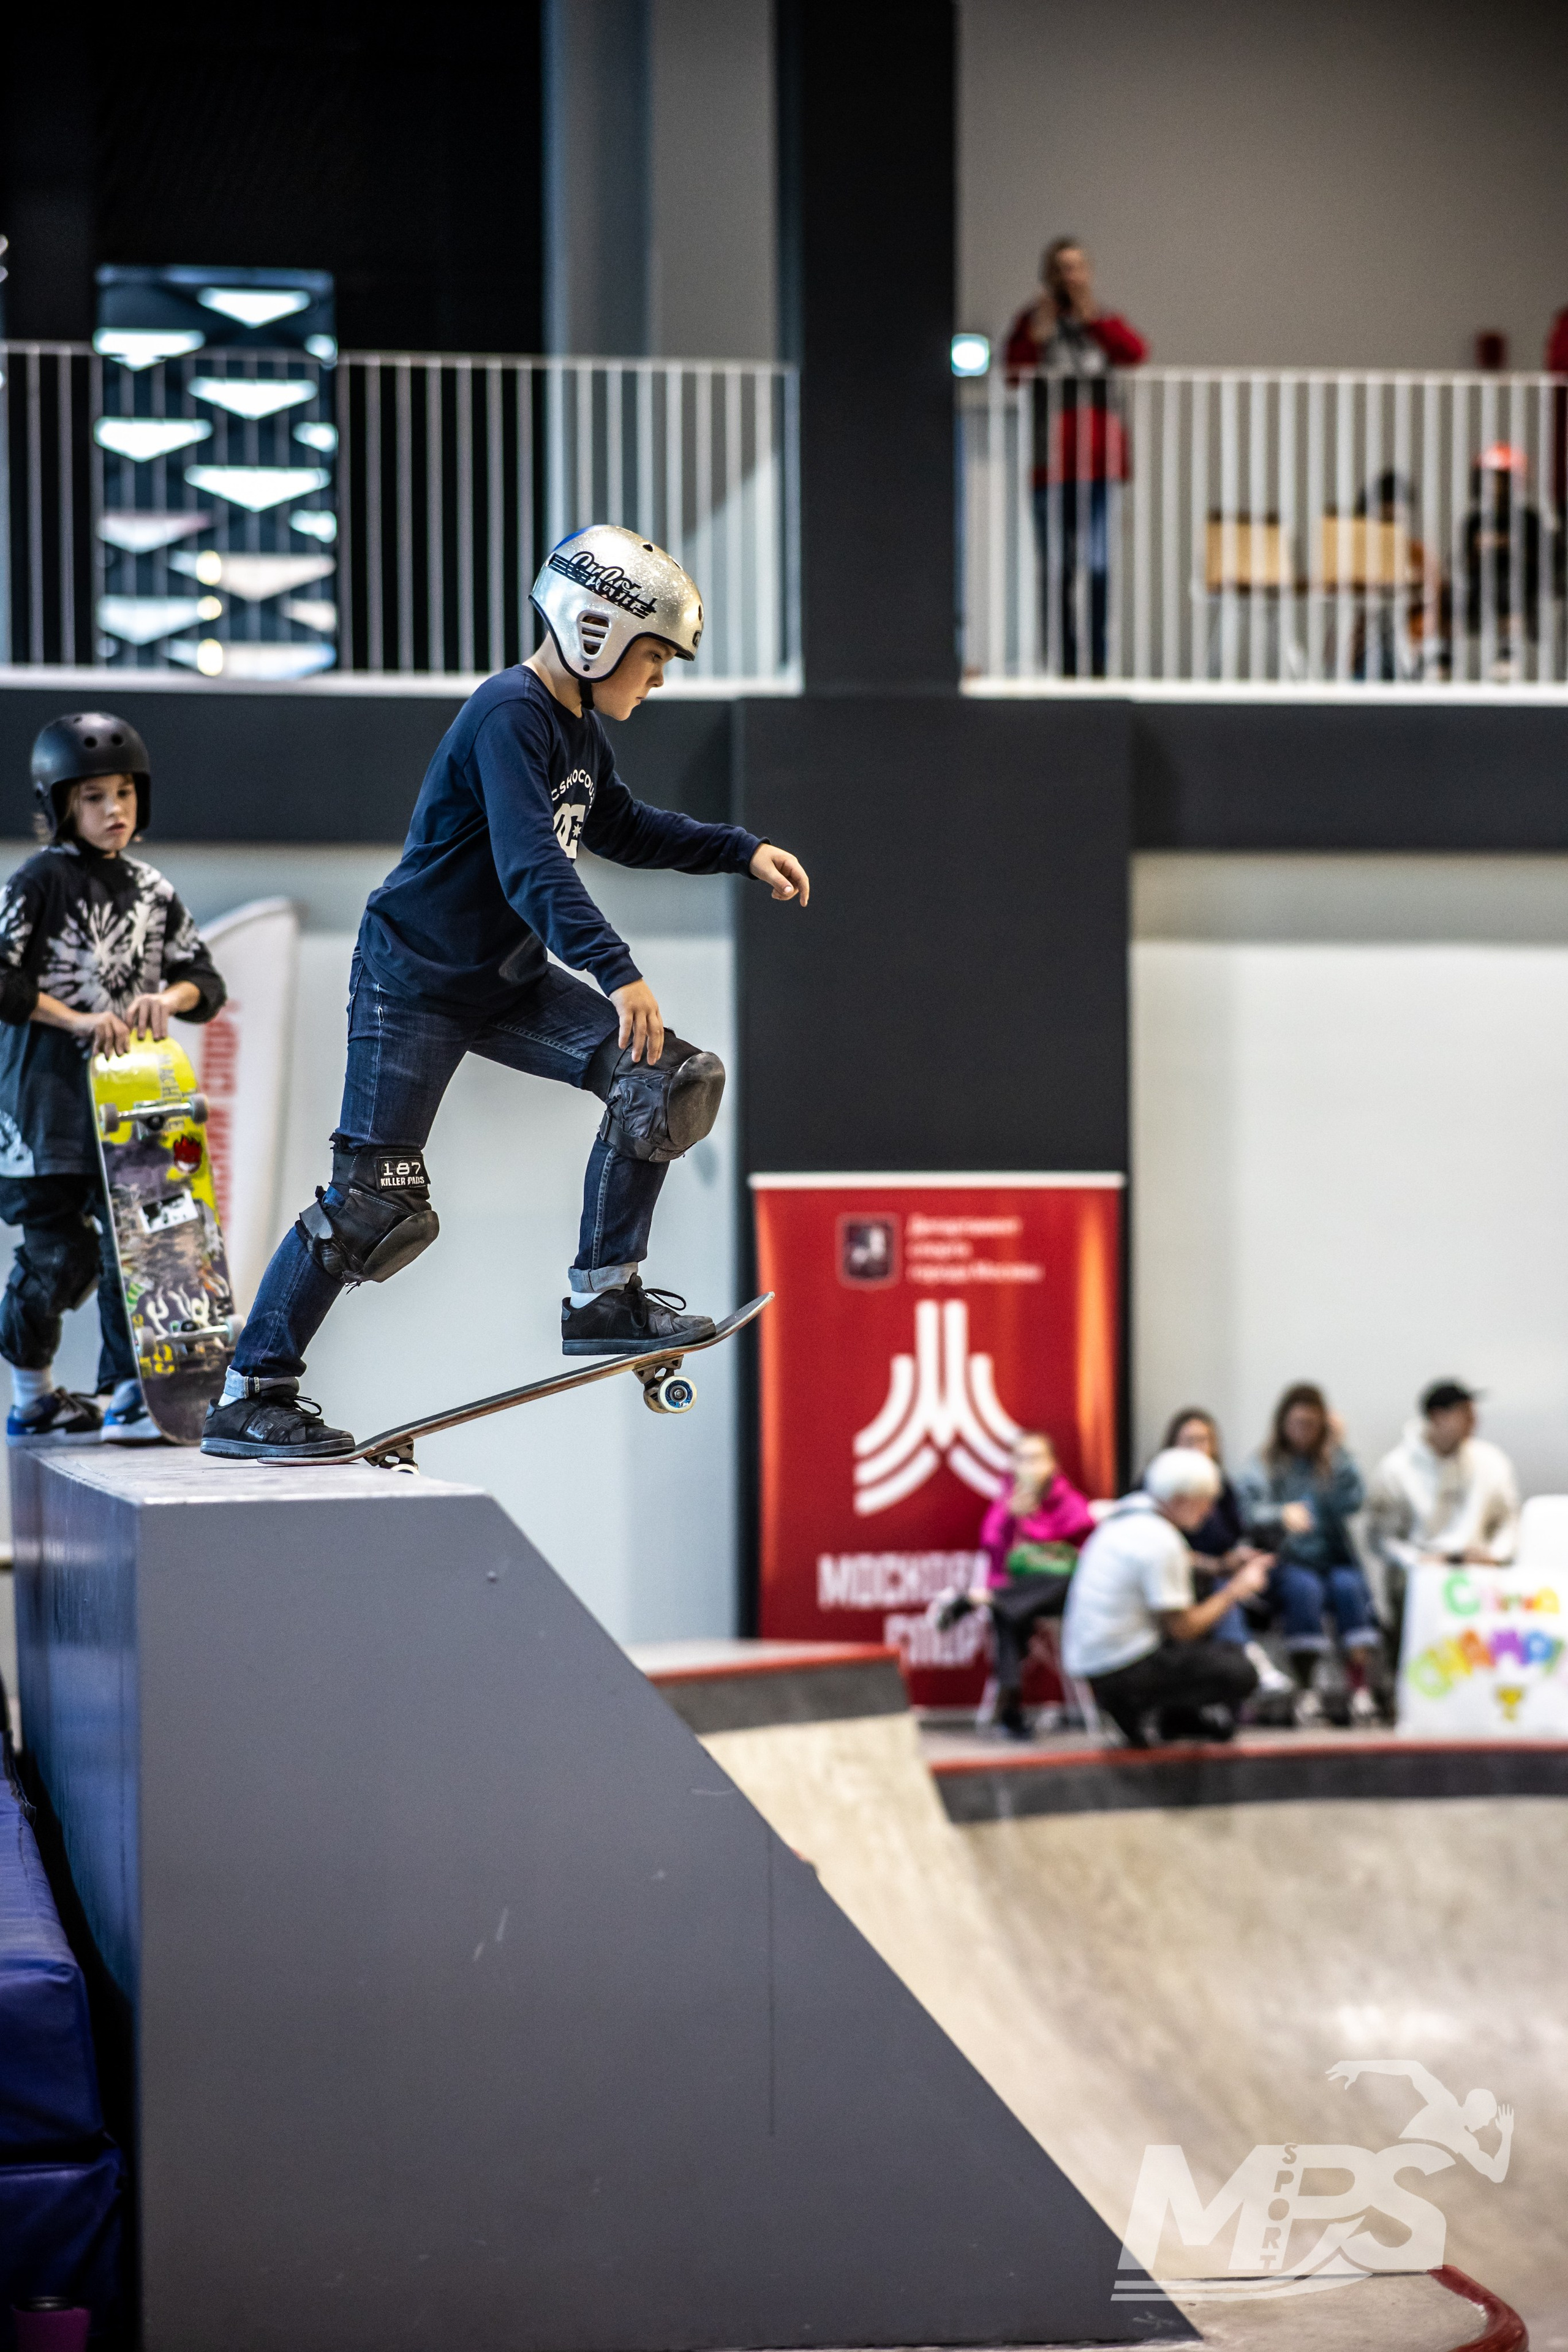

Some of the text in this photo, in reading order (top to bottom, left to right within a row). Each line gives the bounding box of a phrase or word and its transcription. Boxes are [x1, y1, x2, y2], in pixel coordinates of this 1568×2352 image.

[383, 1161, 421, 1176] 187
[380, 1176, 425, 1186] KILLER PADS
